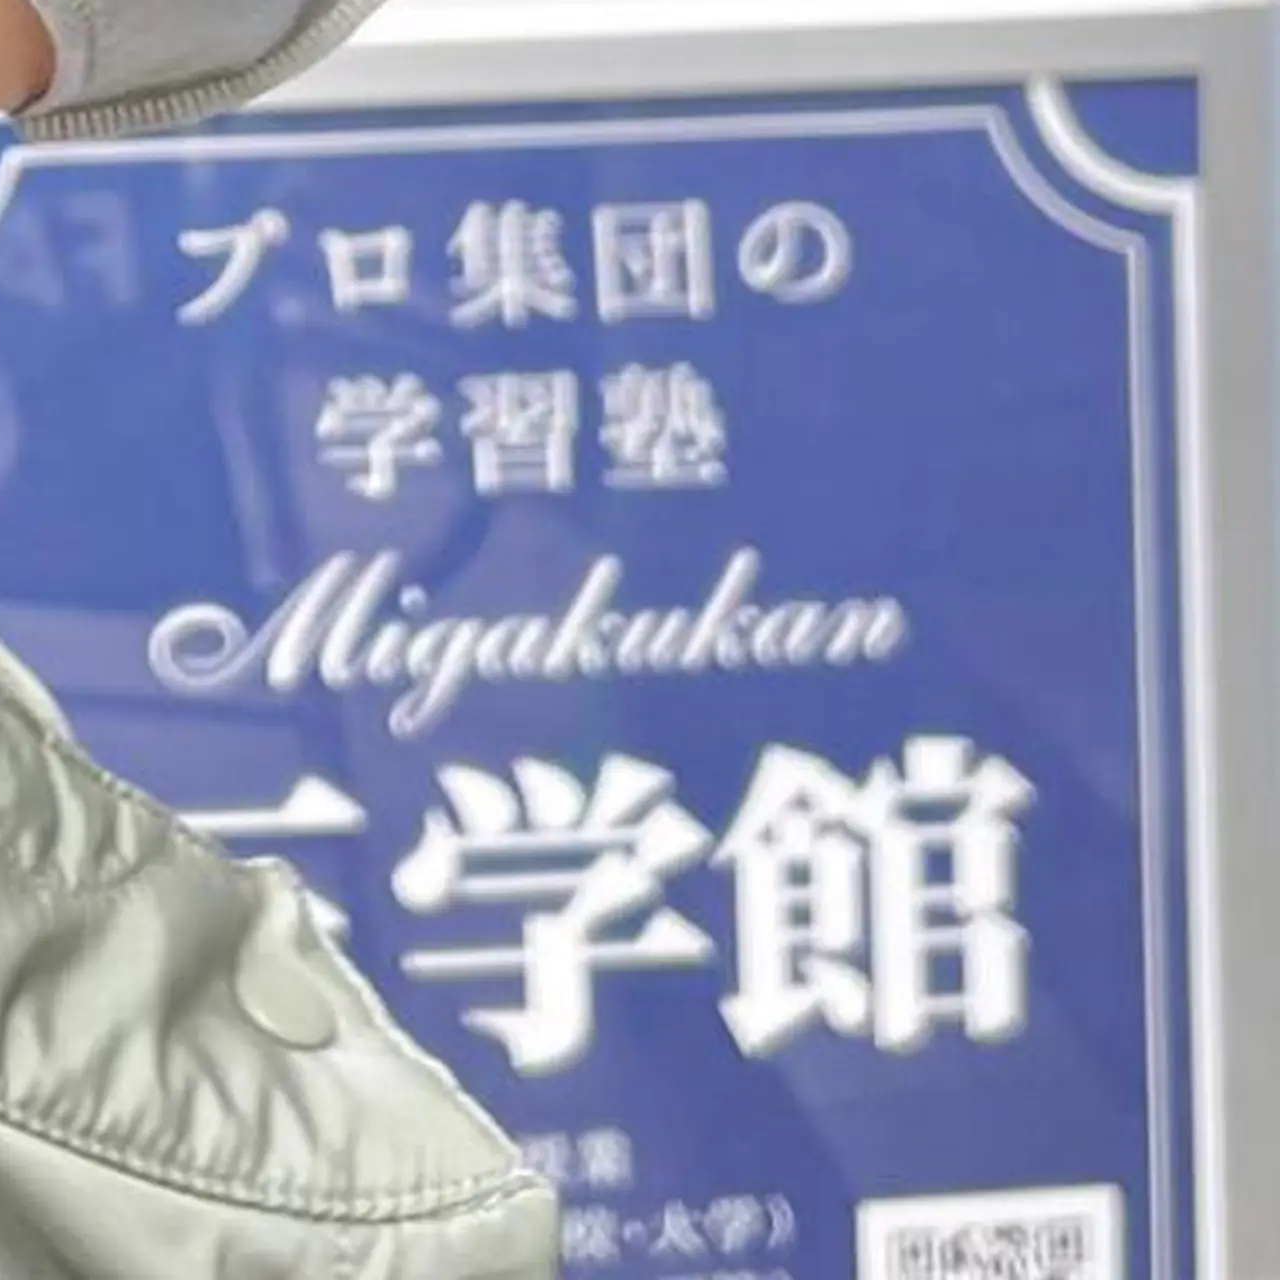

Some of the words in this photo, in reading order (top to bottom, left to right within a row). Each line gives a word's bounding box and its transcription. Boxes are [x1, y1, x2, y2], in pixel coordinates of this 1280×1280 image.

[174, 198, 854, 327] プロ集団の
[311, 361, 728, 497] 学習塾
[146, 545, 910, 737] Migakukan
